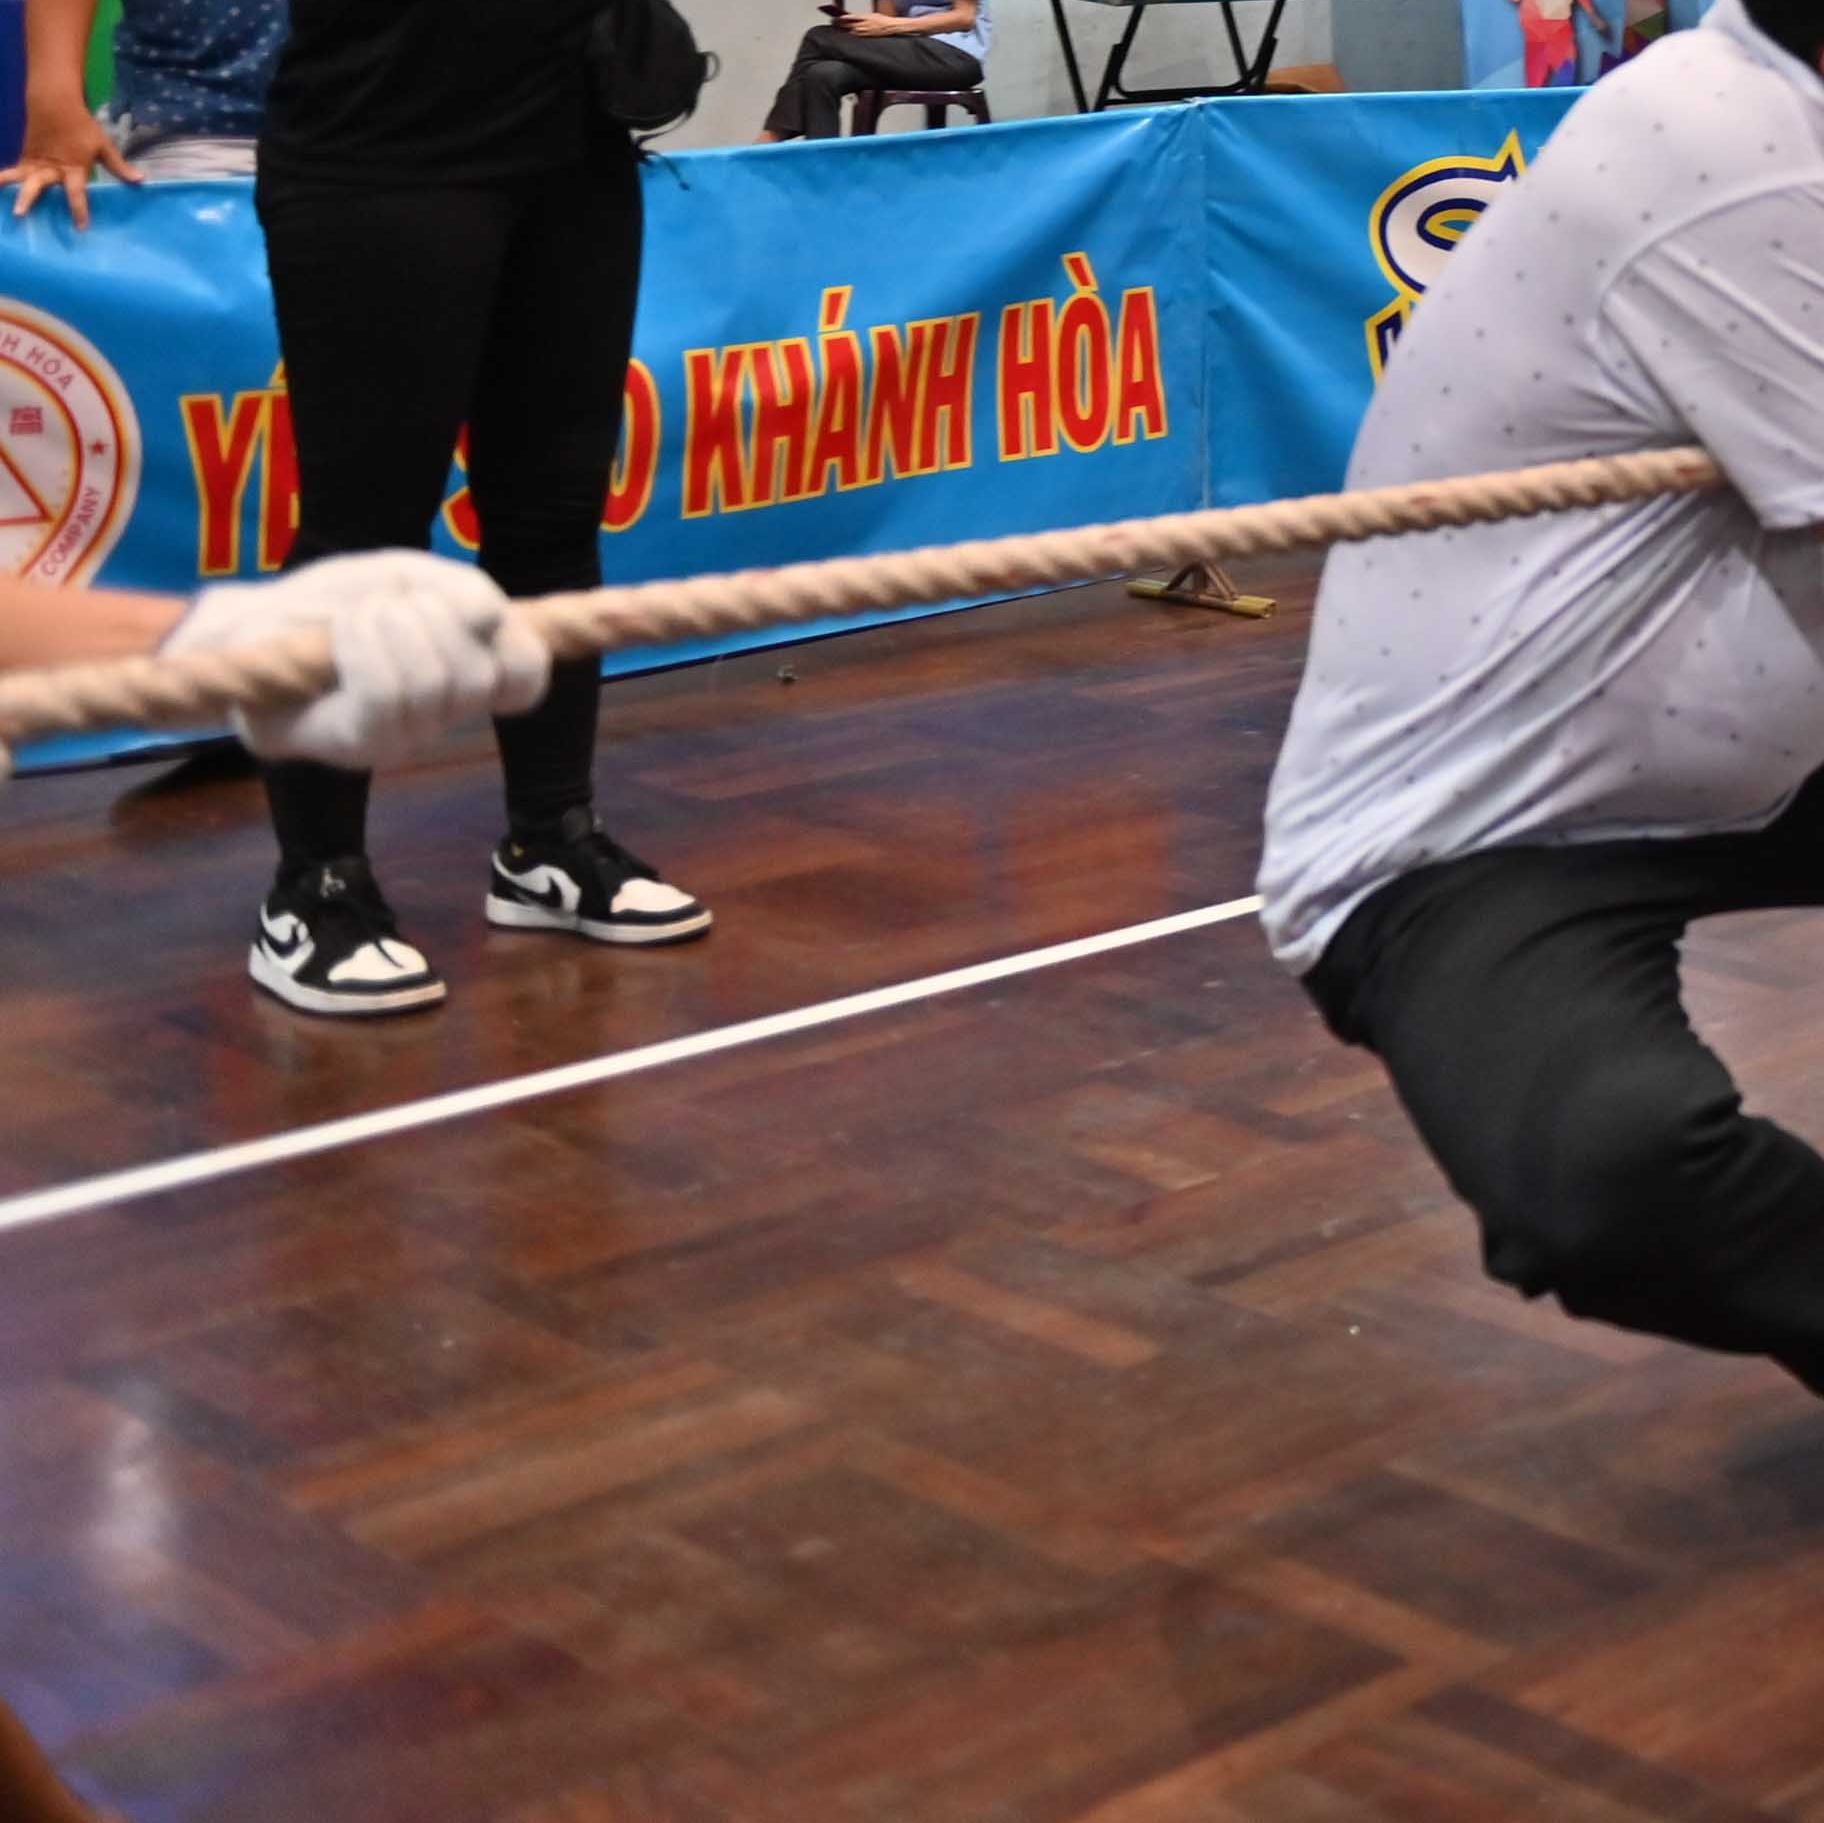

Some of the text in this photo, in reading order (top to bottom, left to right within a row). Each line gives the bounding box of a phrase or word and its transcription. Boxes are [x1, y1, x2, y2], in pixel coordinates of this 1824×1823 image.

[681, 284, 981, 520] KHÁNH
[997, 251, 1169, 464] HÒA
[40, 486, 101, 577] COMPANY
